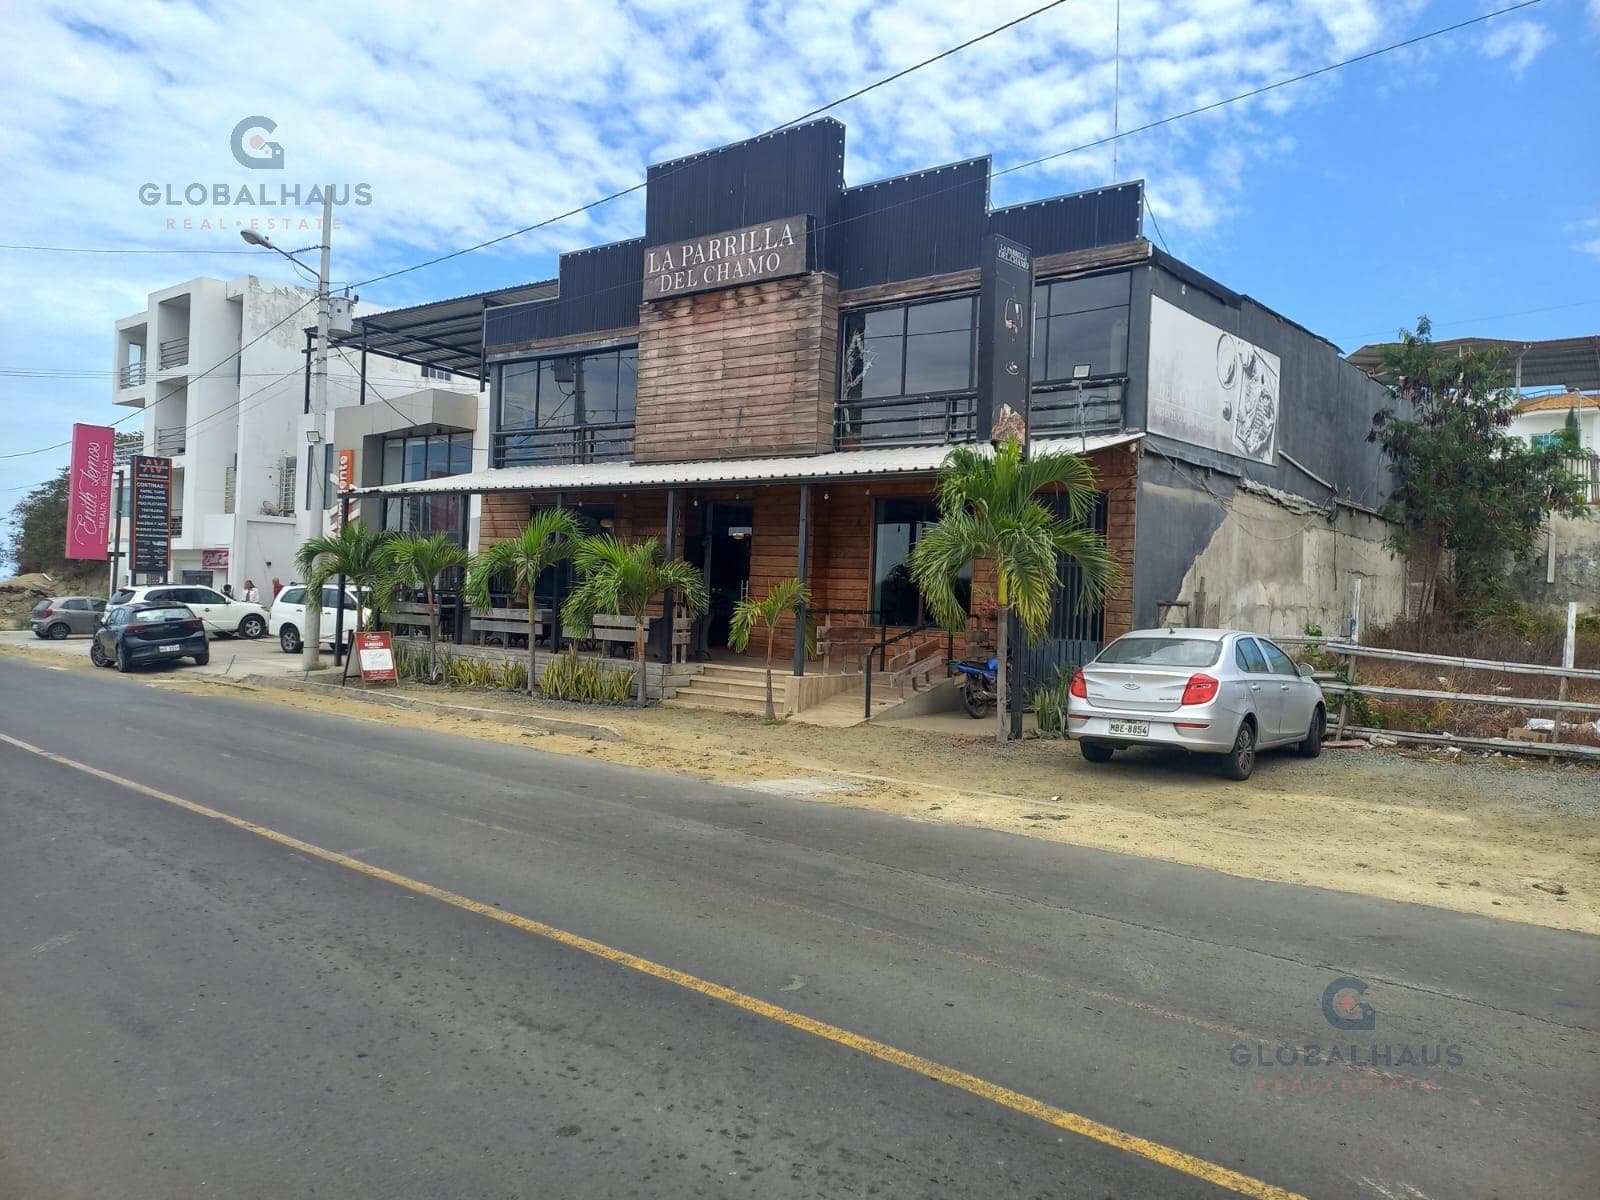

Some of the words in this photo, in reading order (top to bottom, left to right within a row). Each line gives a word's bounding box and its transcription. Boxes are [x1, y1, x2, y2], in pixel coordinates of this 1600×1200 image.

[648, 250, 675, 274] LA
[681, 223, 796, 267] PARRILLA
[660, 270, 698, 292] DEL
[703, 252, 780, 284] CHAMO
